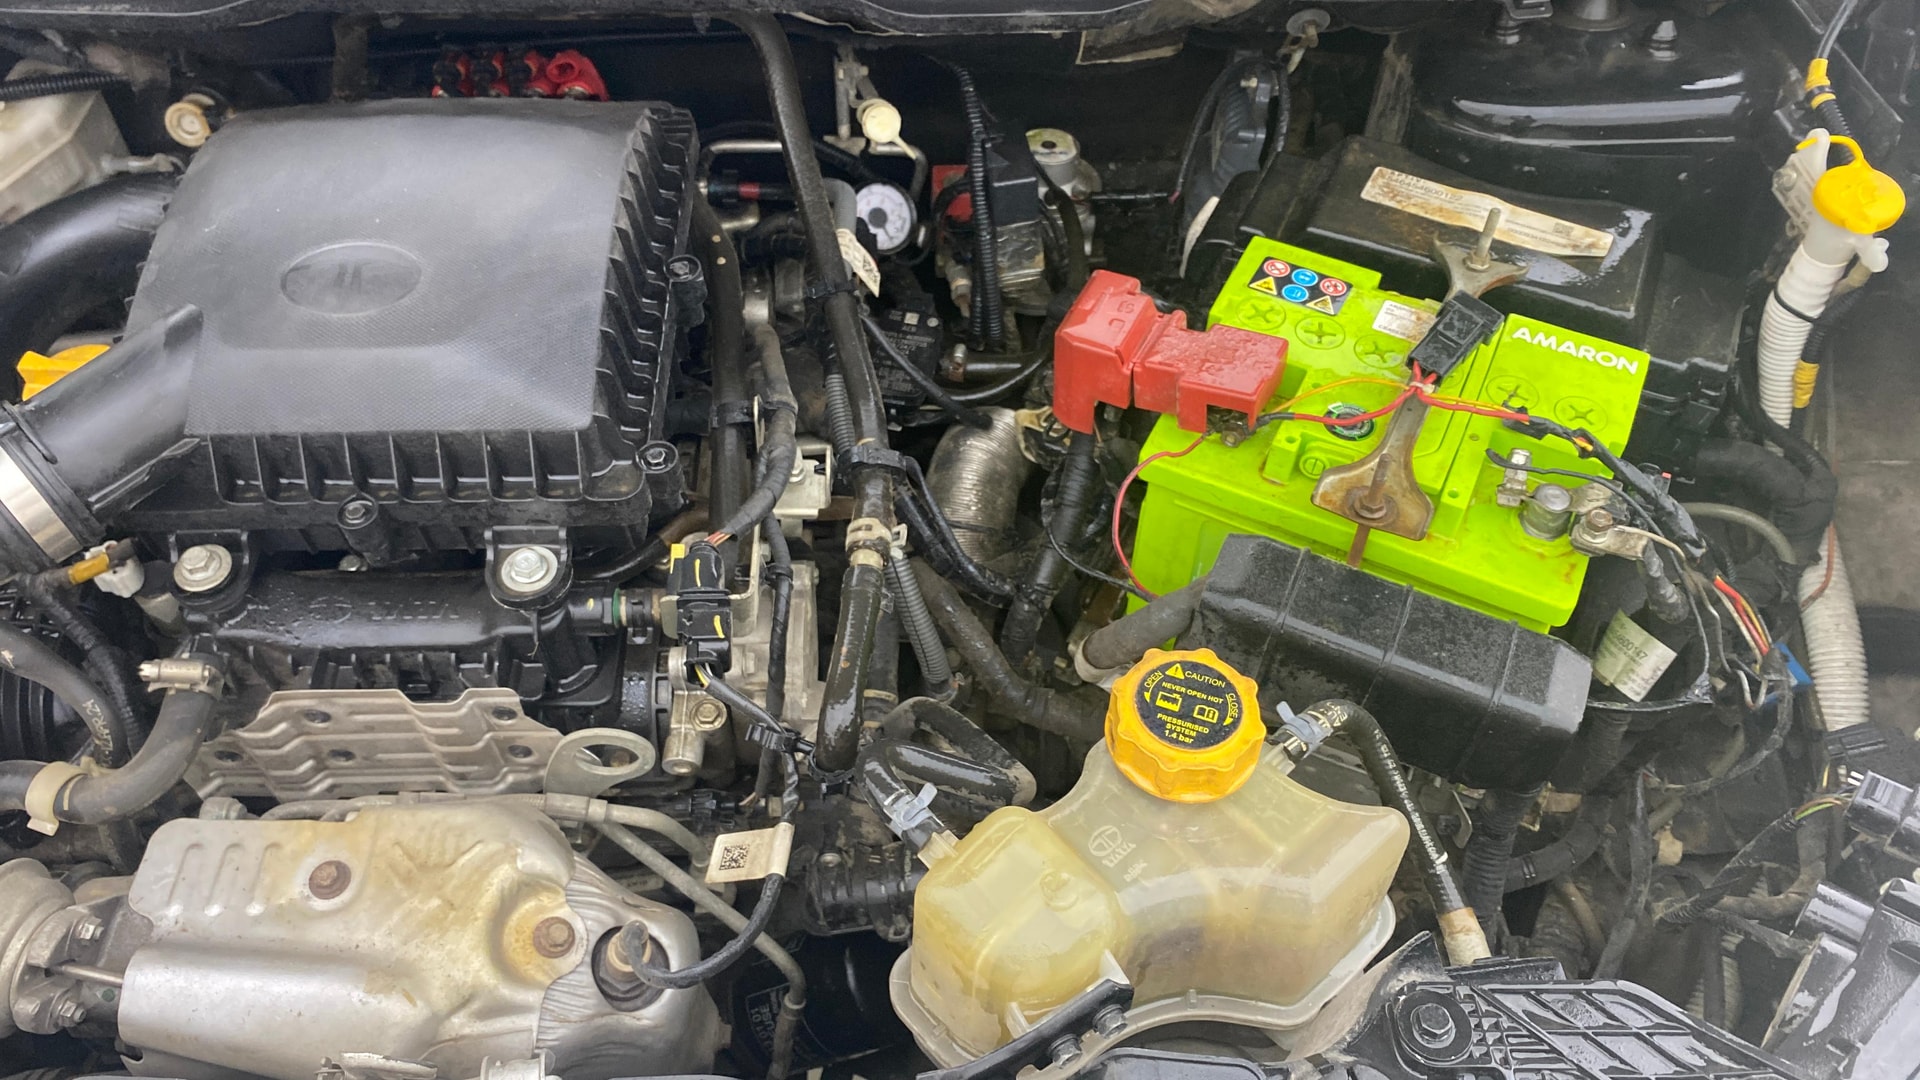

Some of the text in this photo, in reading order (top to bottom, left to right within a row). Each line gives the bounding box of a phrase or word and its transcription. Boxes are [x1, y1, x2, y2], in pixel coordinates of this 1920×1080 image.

[1511, 327, 1639, 375] AMARON
[1144, 670, 1163, 688] OPEN
[1185, 670, 1226, 688] CAUTION
[1162, 681, 1224, 704] NEVER OPEN HOT
[1228, 693, 1239, 718] CLOSE
[1157, 713, 1209, 734] PRESSURISED
[1166, 723, 1197, 737] SYSTEM
[1164, 729, 1194, 744] 1.4 bar
